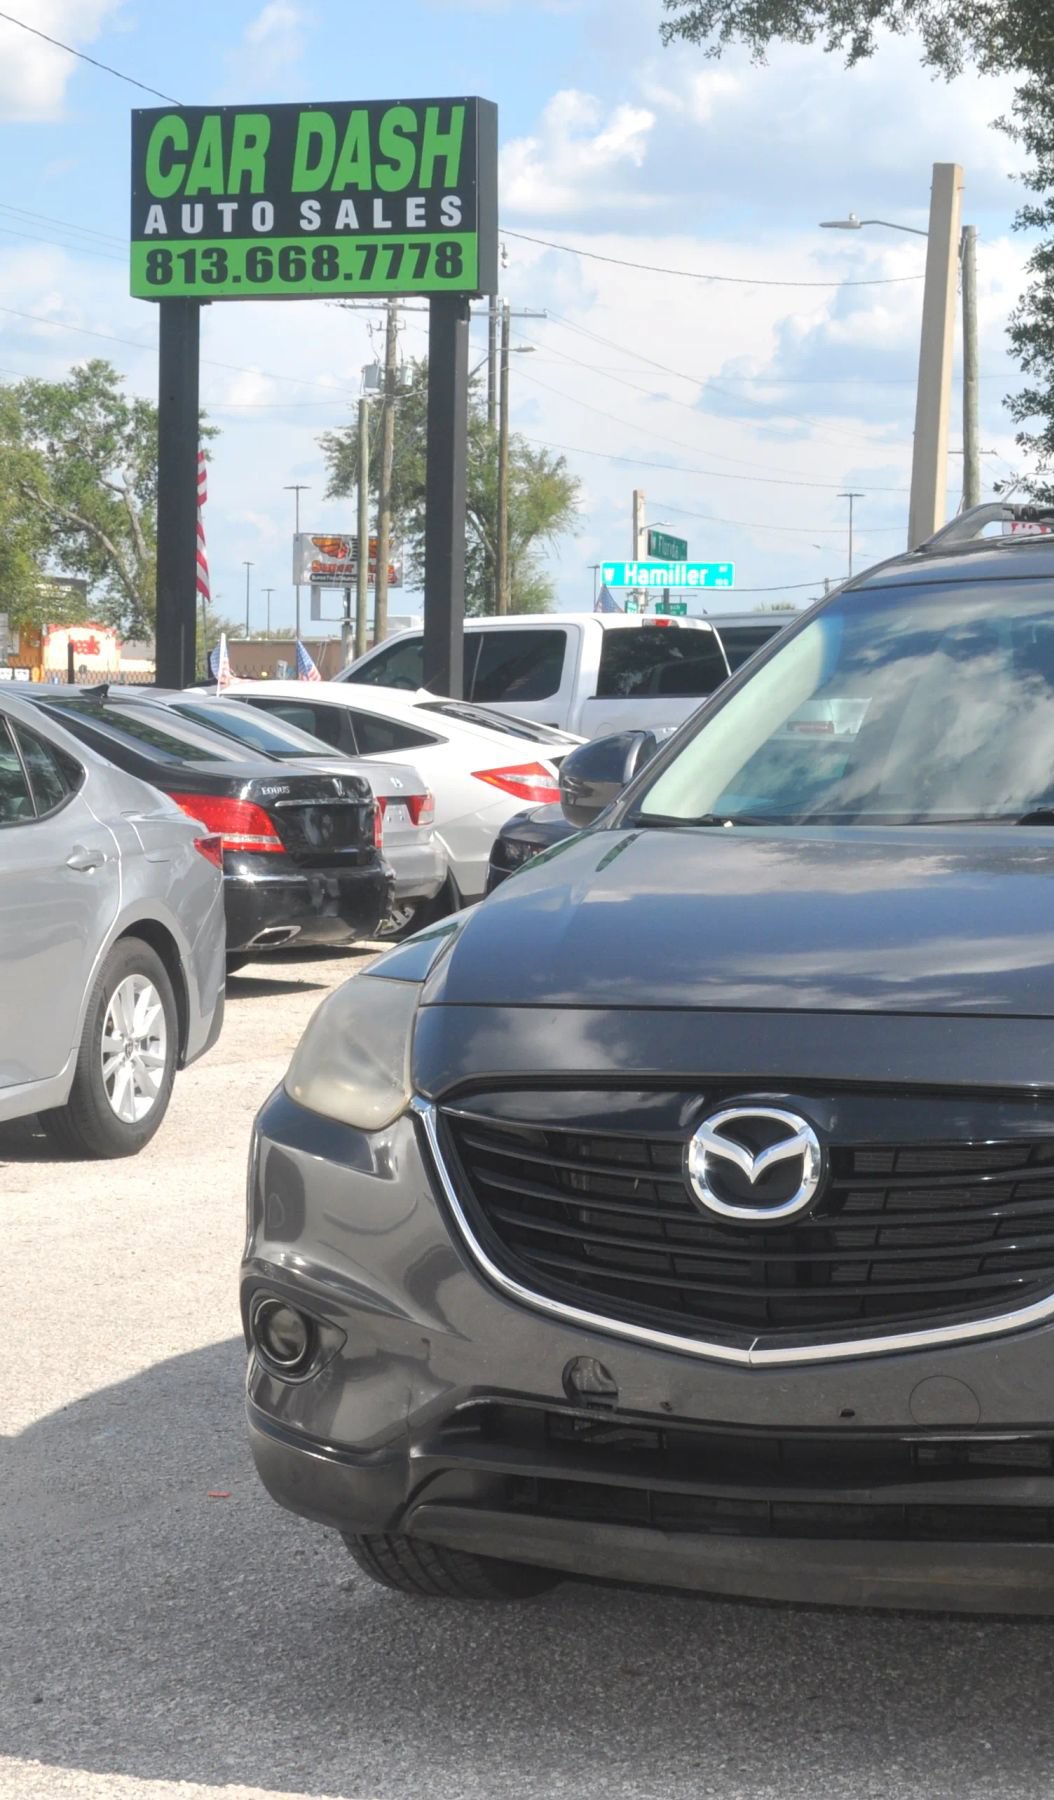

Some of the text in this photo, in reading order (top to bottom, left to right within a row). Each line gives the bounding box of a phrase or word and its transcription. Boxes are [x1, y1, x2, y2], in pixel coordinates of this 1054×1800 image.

[145, 106, 466, 198] CAR DASH
[144, 195, 463, 234] AUTO SALES
[145, 240, 463, 285] 813.668.7778
[624, 563, 709, 586] Hamiller
